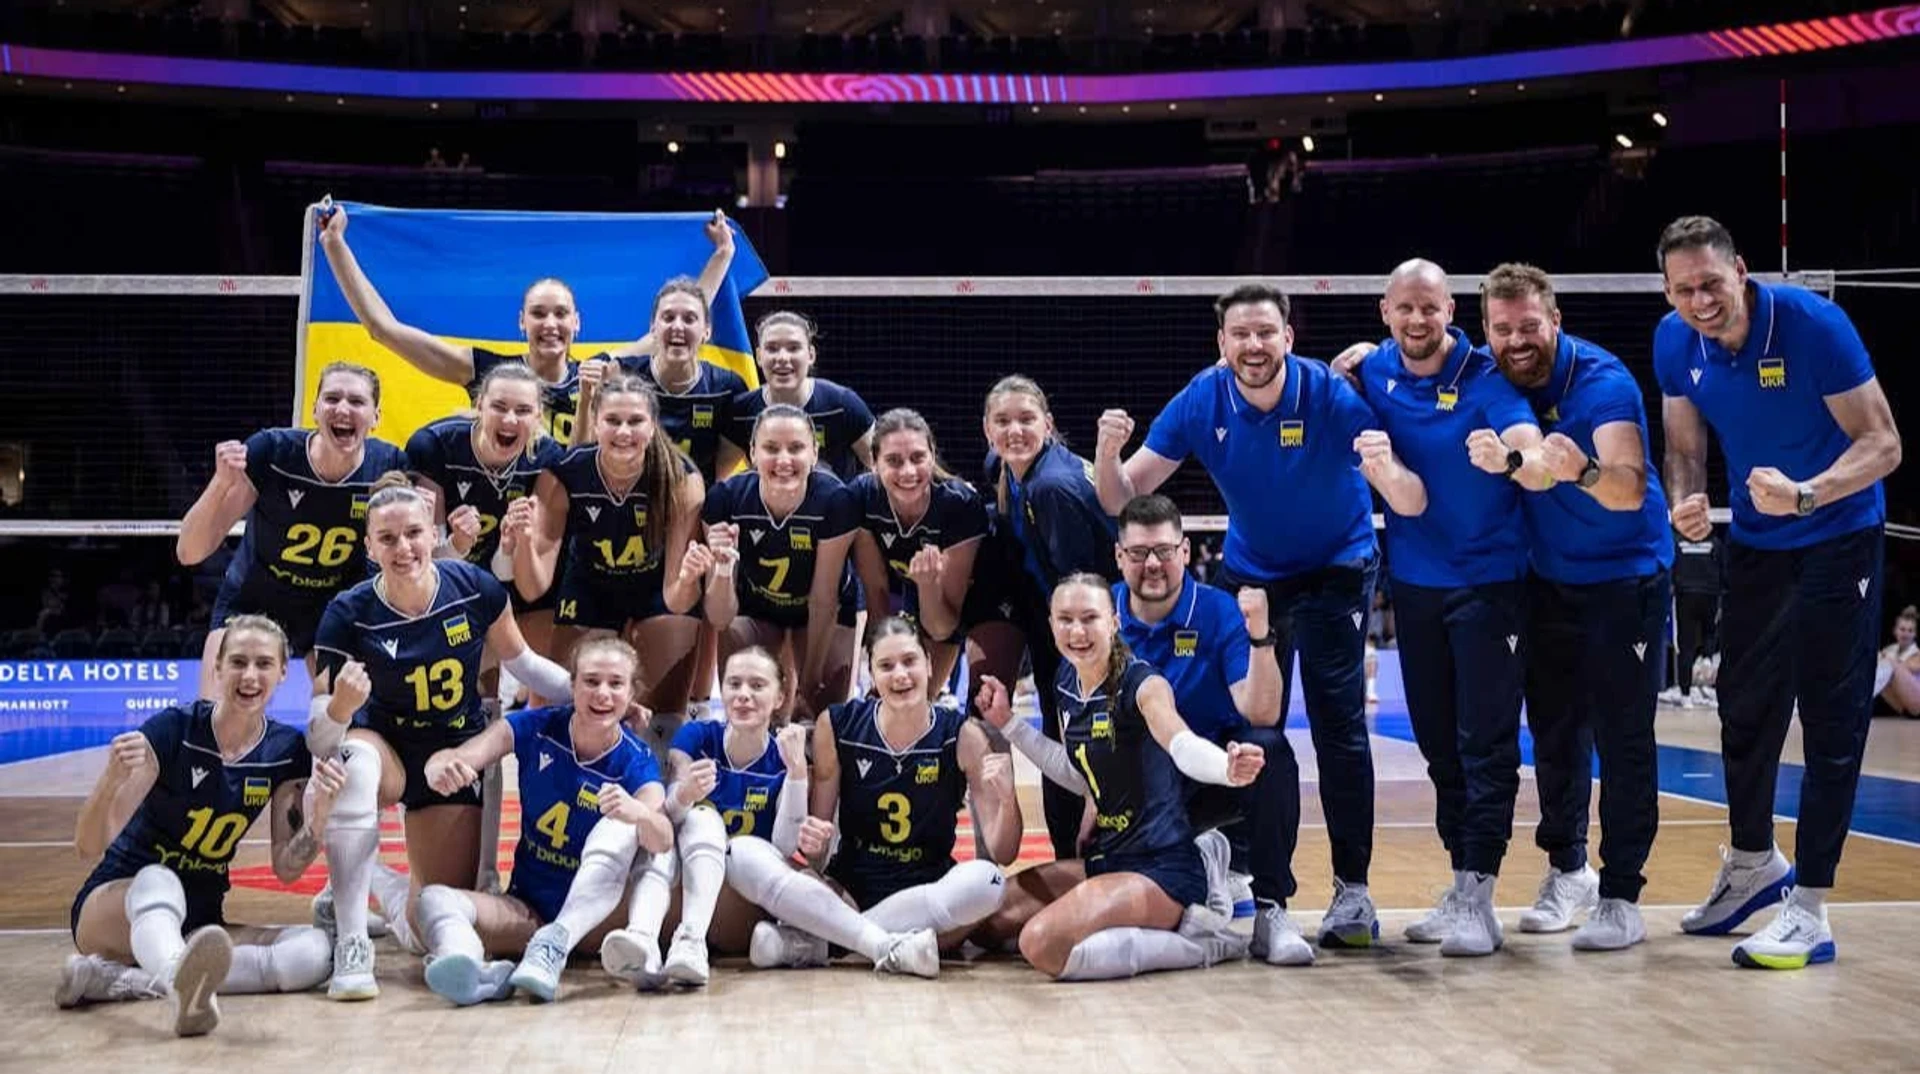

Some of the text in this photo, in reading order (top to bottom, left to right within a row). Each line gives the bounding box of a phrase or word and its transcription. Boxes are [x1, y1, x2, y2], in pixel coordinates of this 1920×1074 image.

[1759, 376, 1786, 388] UKR
[281, 524, 357, 567] 26
[592, 534, 646, 569] 14
[758, 556, 791, 593] 7
[559, 598, 577, 619] 14
[447, 630, 472, 648] UKR
[0, 662, 180, 682] DELTA HOTELS
[404, 657, 465, 713] 13
[1074, 742, 1101, 800] 1
[180, 806, 249, 859] 10
[535, 800, 571, 850] 4
[876, 791, 912, 844] 3
